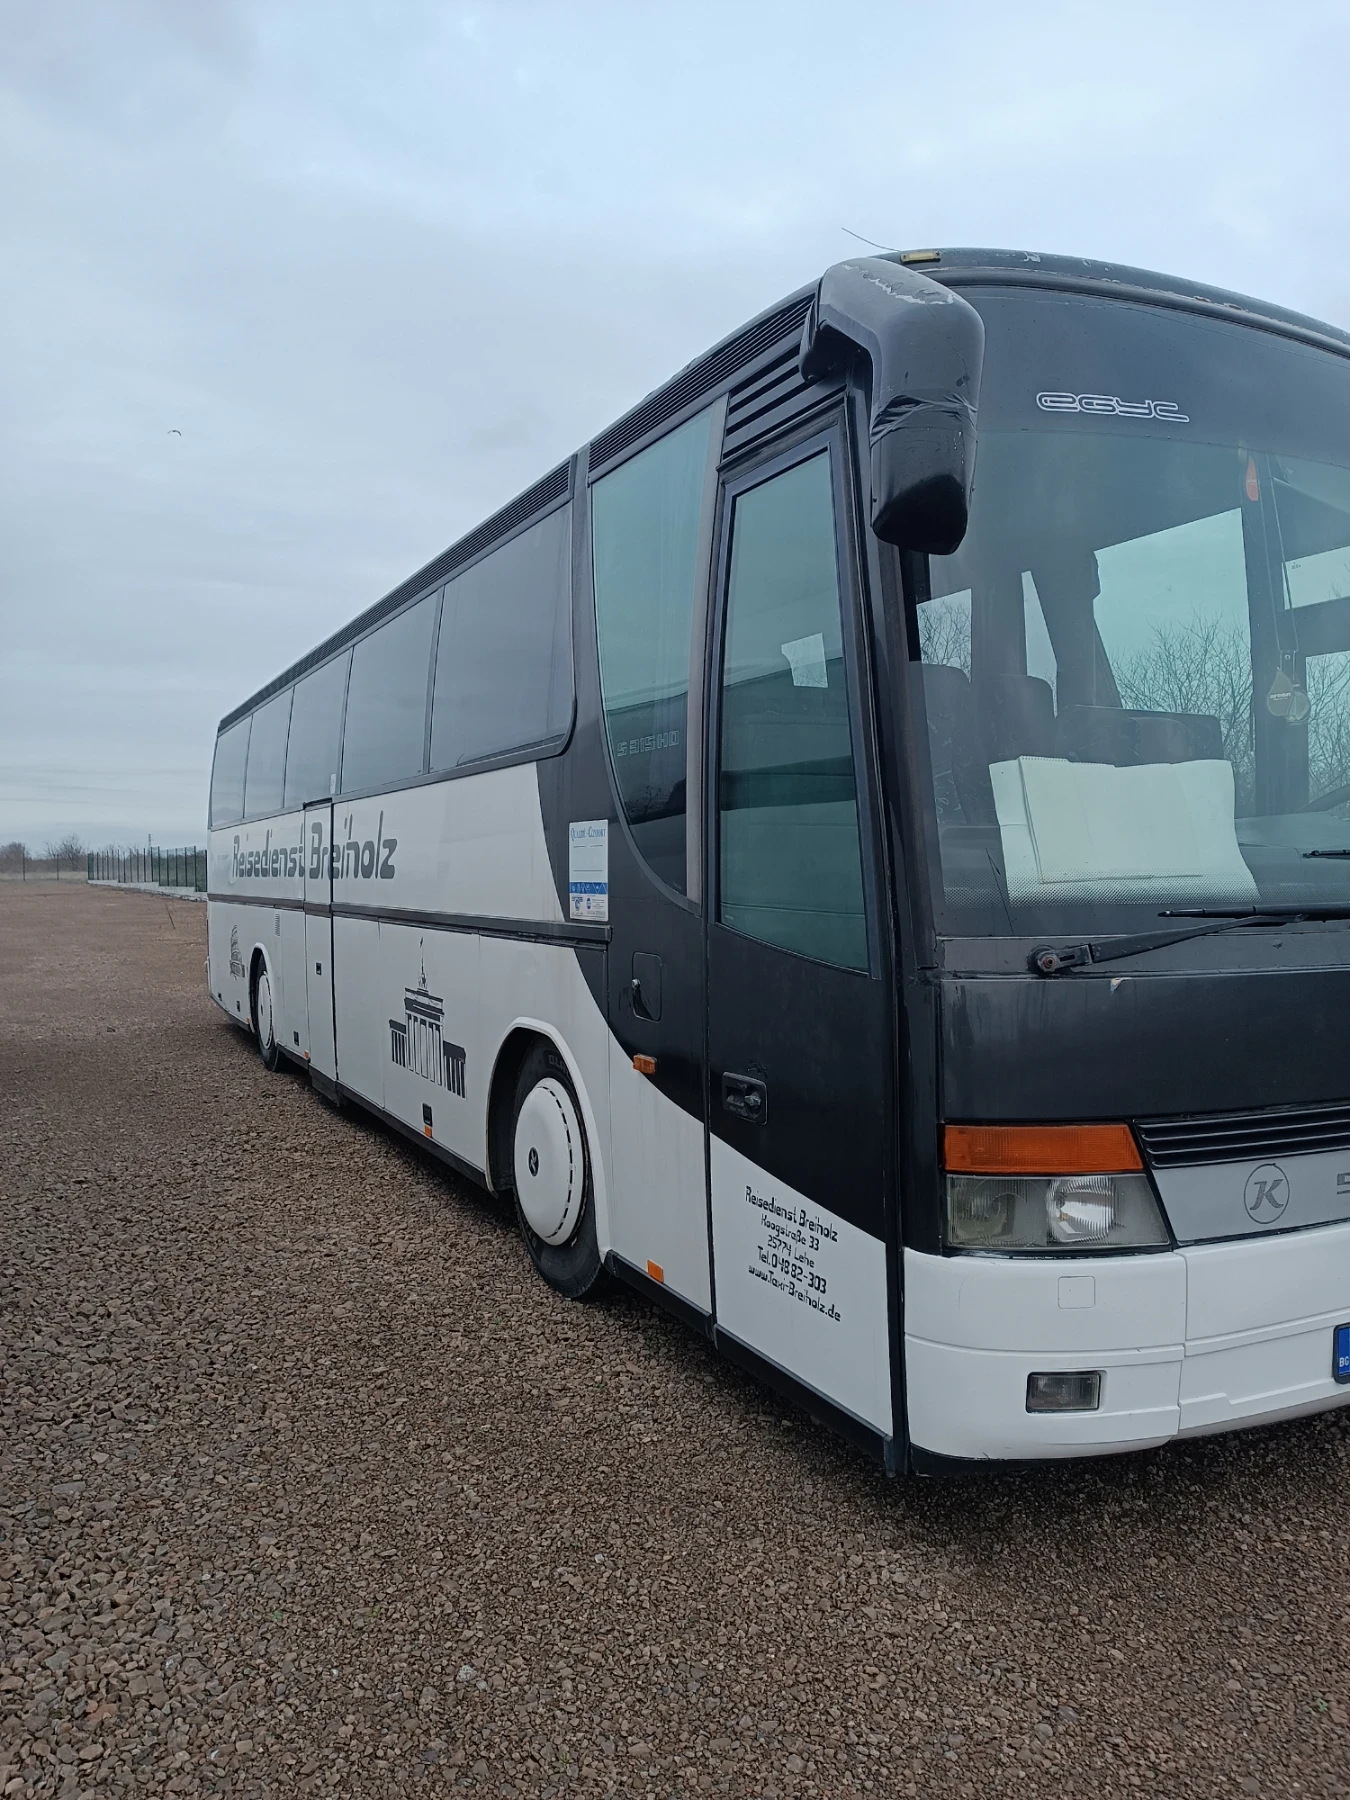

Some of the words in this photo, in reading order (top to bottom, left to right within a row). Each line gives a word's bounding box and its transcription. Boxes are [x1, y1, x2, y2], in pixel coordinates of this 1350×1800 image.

[232, 822, 305, 878] Reisedienst
[309, 810, 397, 880] Breiholz
[745, 1185, 798, 1224] Reisedienst
[799, 1209, 838, 1242] Breiholz
[1250, 1178, 1285, 1211] K
[760, 1213, 807, 1245] Koogstraße
[808, 1235, 820, 1251] 33
[767, 1234, 792, 1257] 25774
[794, 1247, 815, 1269] Lehe
[748, 1265, 841, 1322] www.Taxi-Breiholz.de
[1339, 1356, 1350, 1368] BG
